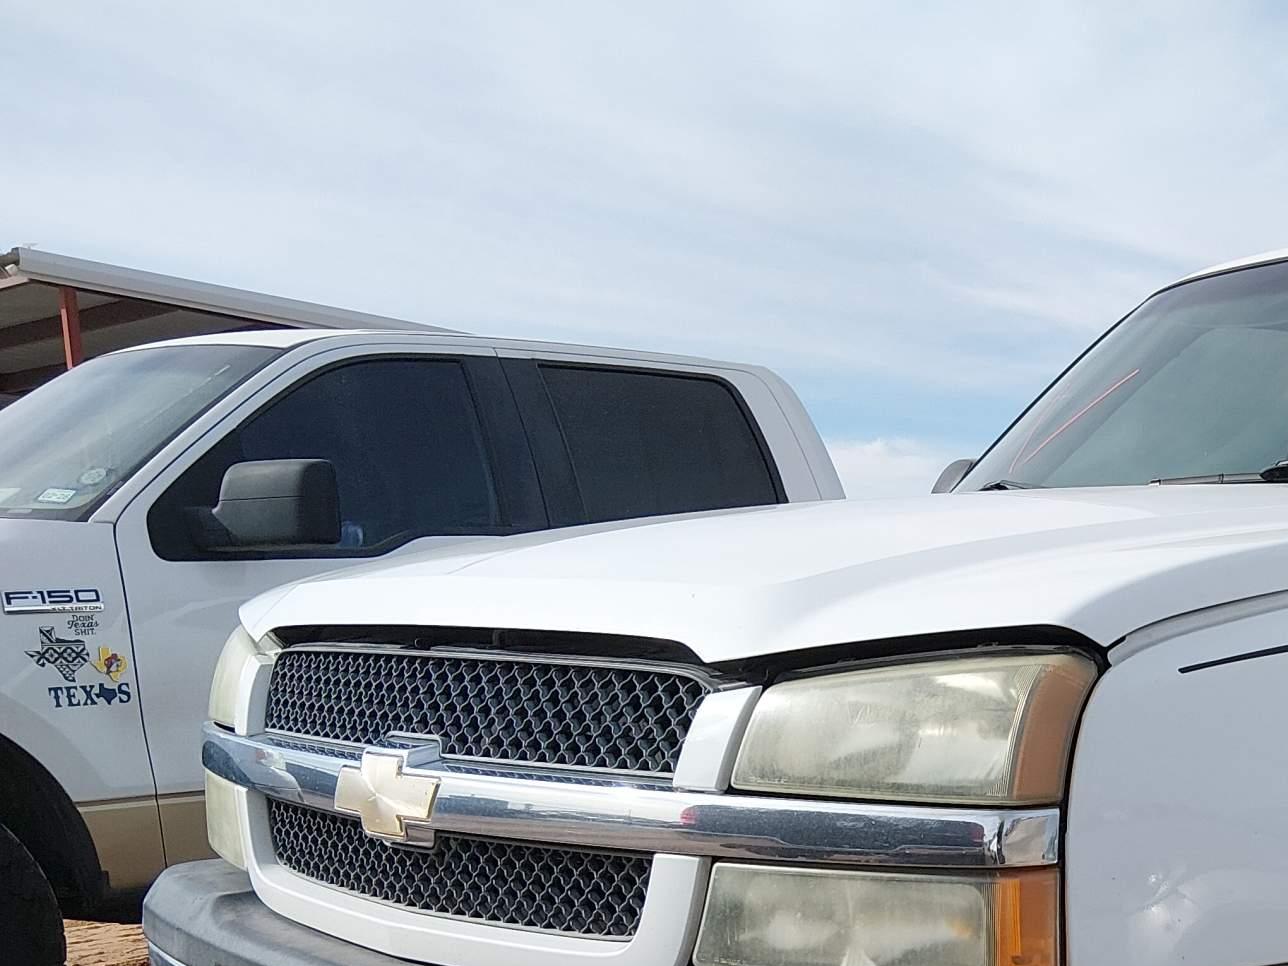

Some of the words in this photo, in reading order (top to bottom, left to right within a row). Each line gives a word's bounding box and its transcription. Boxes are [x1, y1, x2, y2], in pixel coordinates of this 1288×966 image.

[4, 588, 101, 606] F-150
[67, 620, 100, 630] Texas
[48, 682, 131, 708] TEXS
